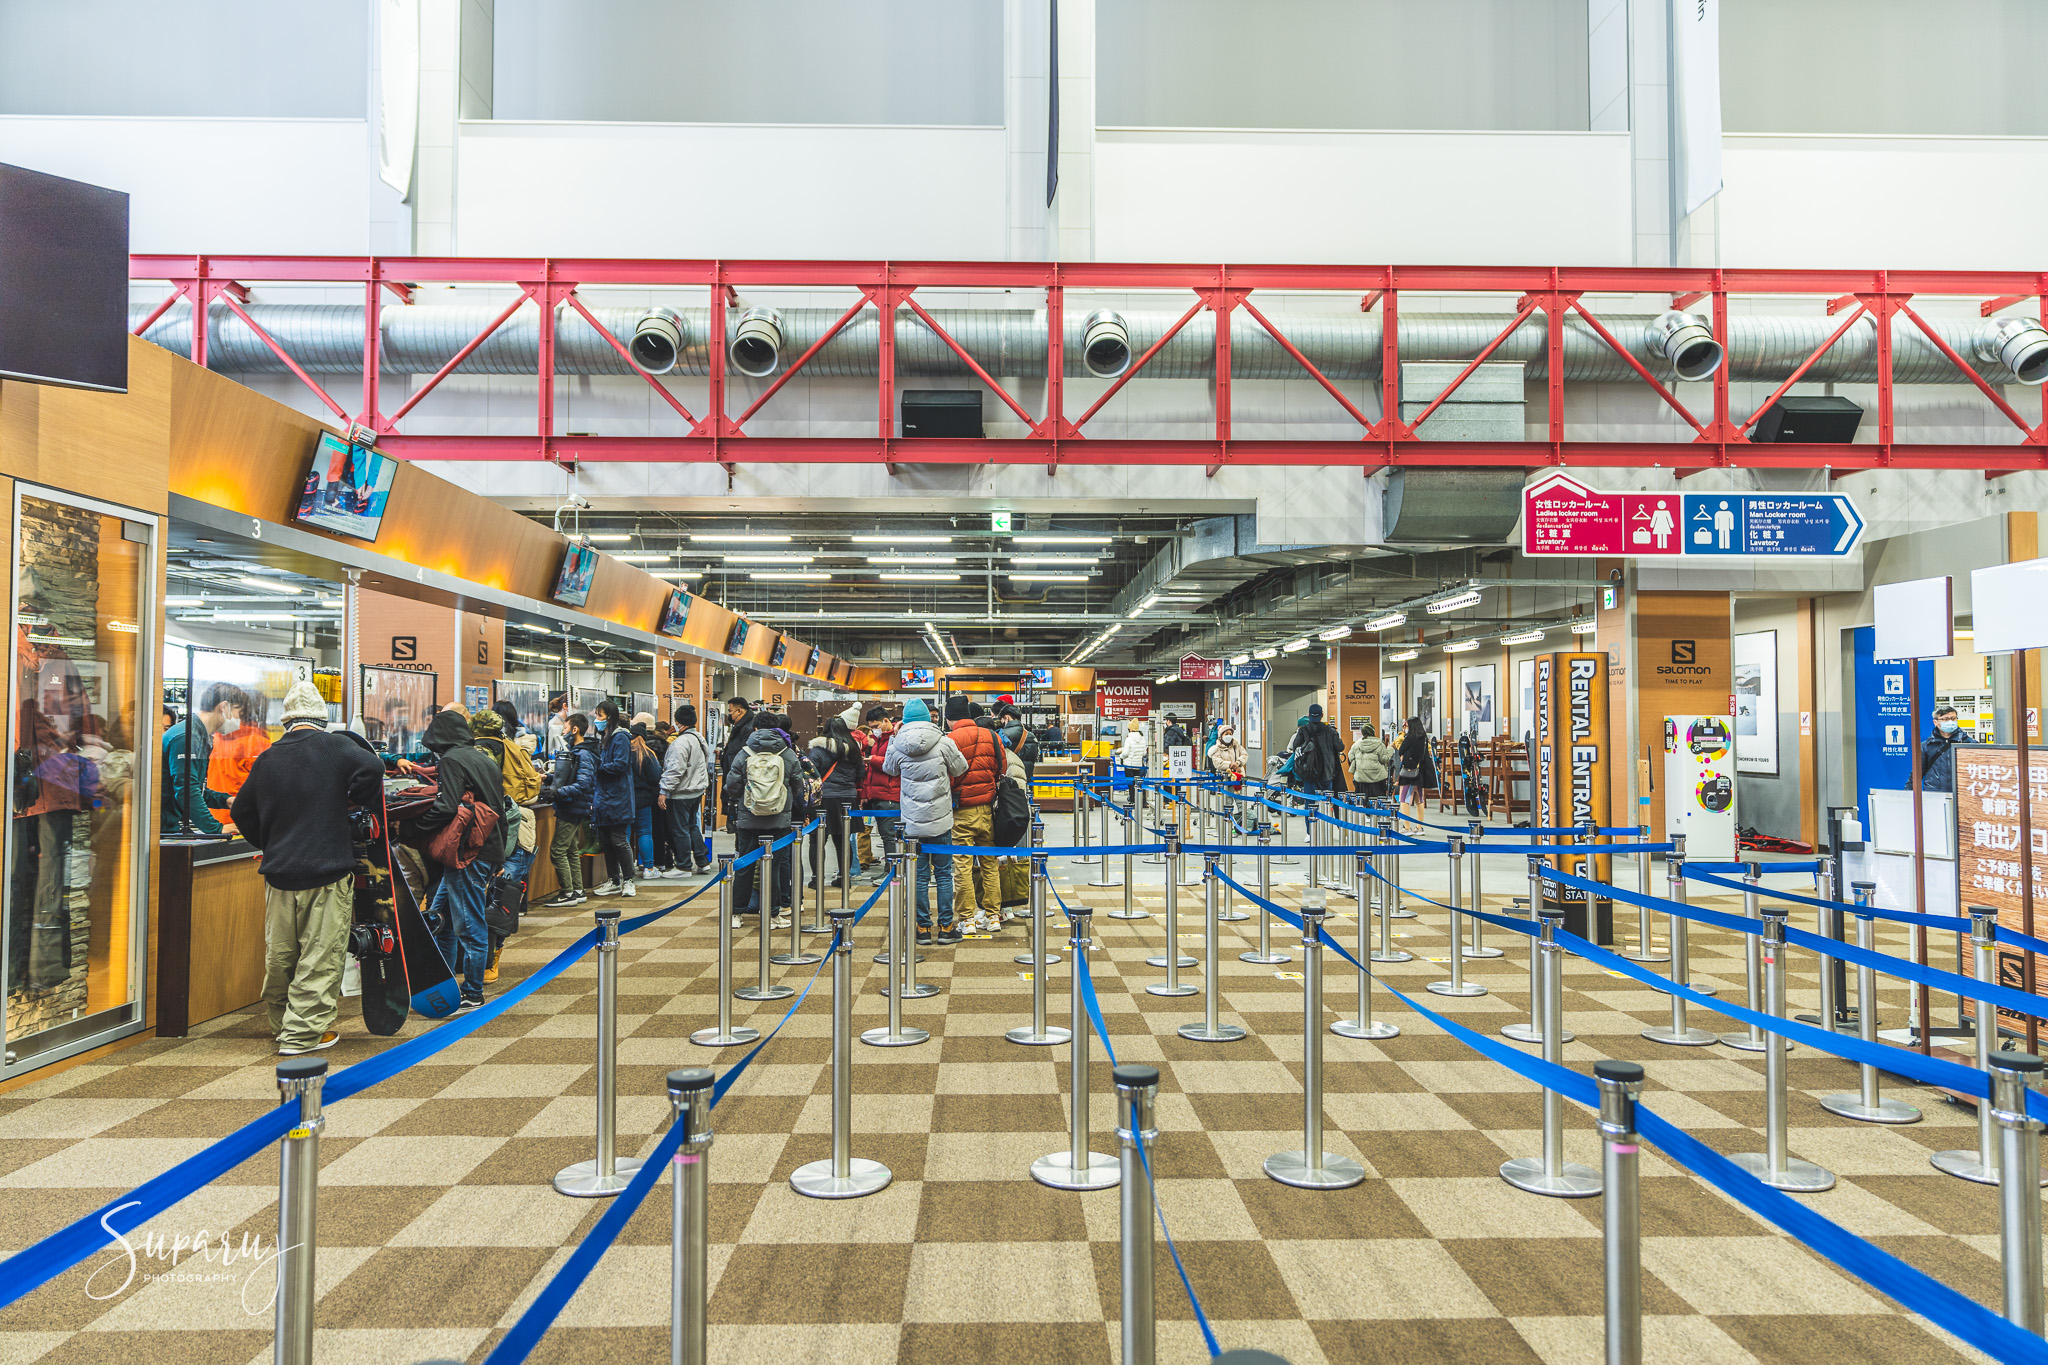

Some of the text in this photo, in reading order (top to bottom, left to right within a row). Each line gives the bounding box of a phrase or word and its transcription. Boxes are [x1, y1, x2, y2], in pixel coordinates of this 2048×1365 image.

[1535, 500, 1610, 509] 女性ロッカールーム
[1749, 501, 1823, 510] 男性ロッカールーム
[251, 518, 261, 539] 3
[1536, 538, 1566, 546] Lavatory
[417, 567, 423, 582] 4
[536, 602, 541, 614] 5
[298, 665, 306, 681] 3
[1656, 665, 1711, 675] salomon
[366, 677, 373, 690] 4
[1103, 686, 1149, 696] WOMEN
[1538, 661, 1550, 742] RENTAL
[1571, 660, 1596, 742] RENTAL
[1173, 750, 1186, 758] 出口
[1173, 759, 1187, 767] Exit
